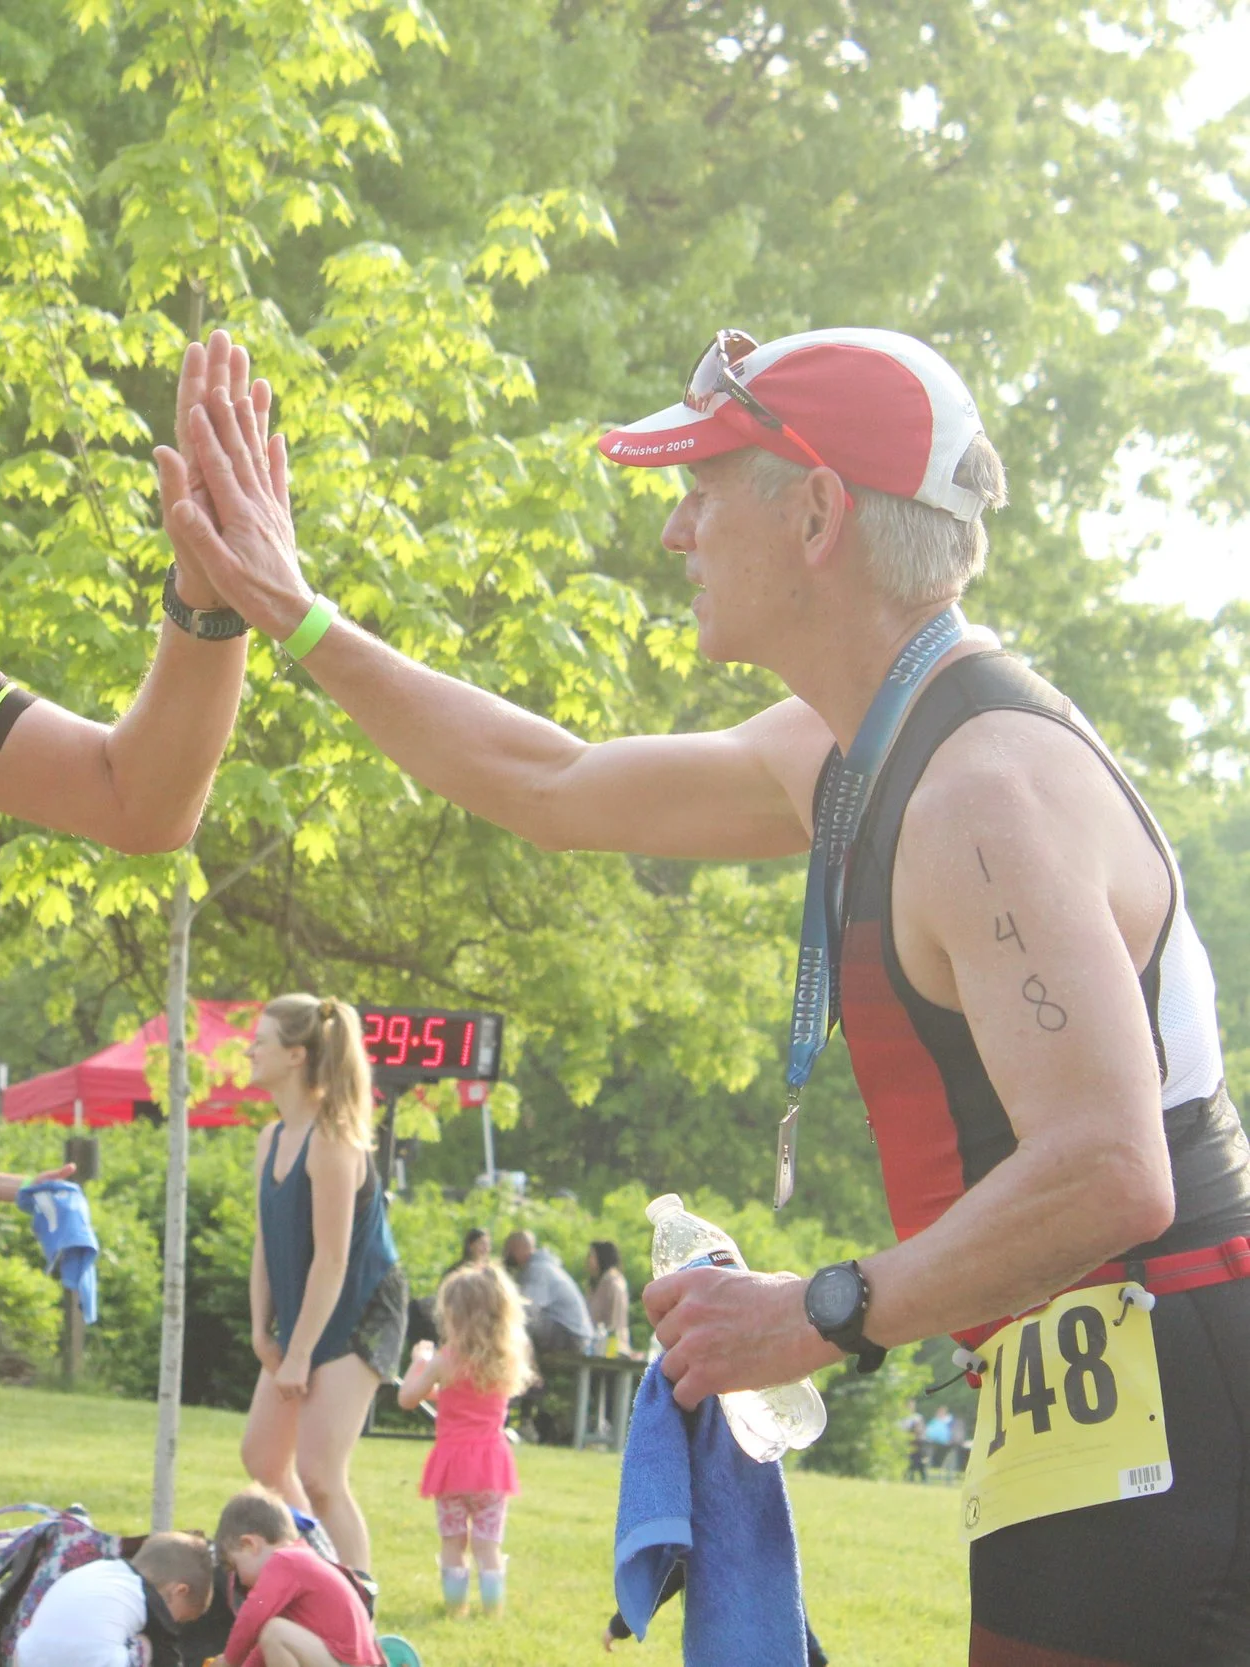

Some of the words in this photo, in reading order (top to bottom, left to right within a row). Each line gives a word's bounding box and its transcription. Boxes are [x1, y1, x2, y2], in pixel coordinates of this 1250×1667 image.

[621, 444, 664, 455] Finisher
[666, 438, 695, 452] 2009
[793, 946, 823, 1045] FINISHER
[986, 1305, 1119, 1459] 148
